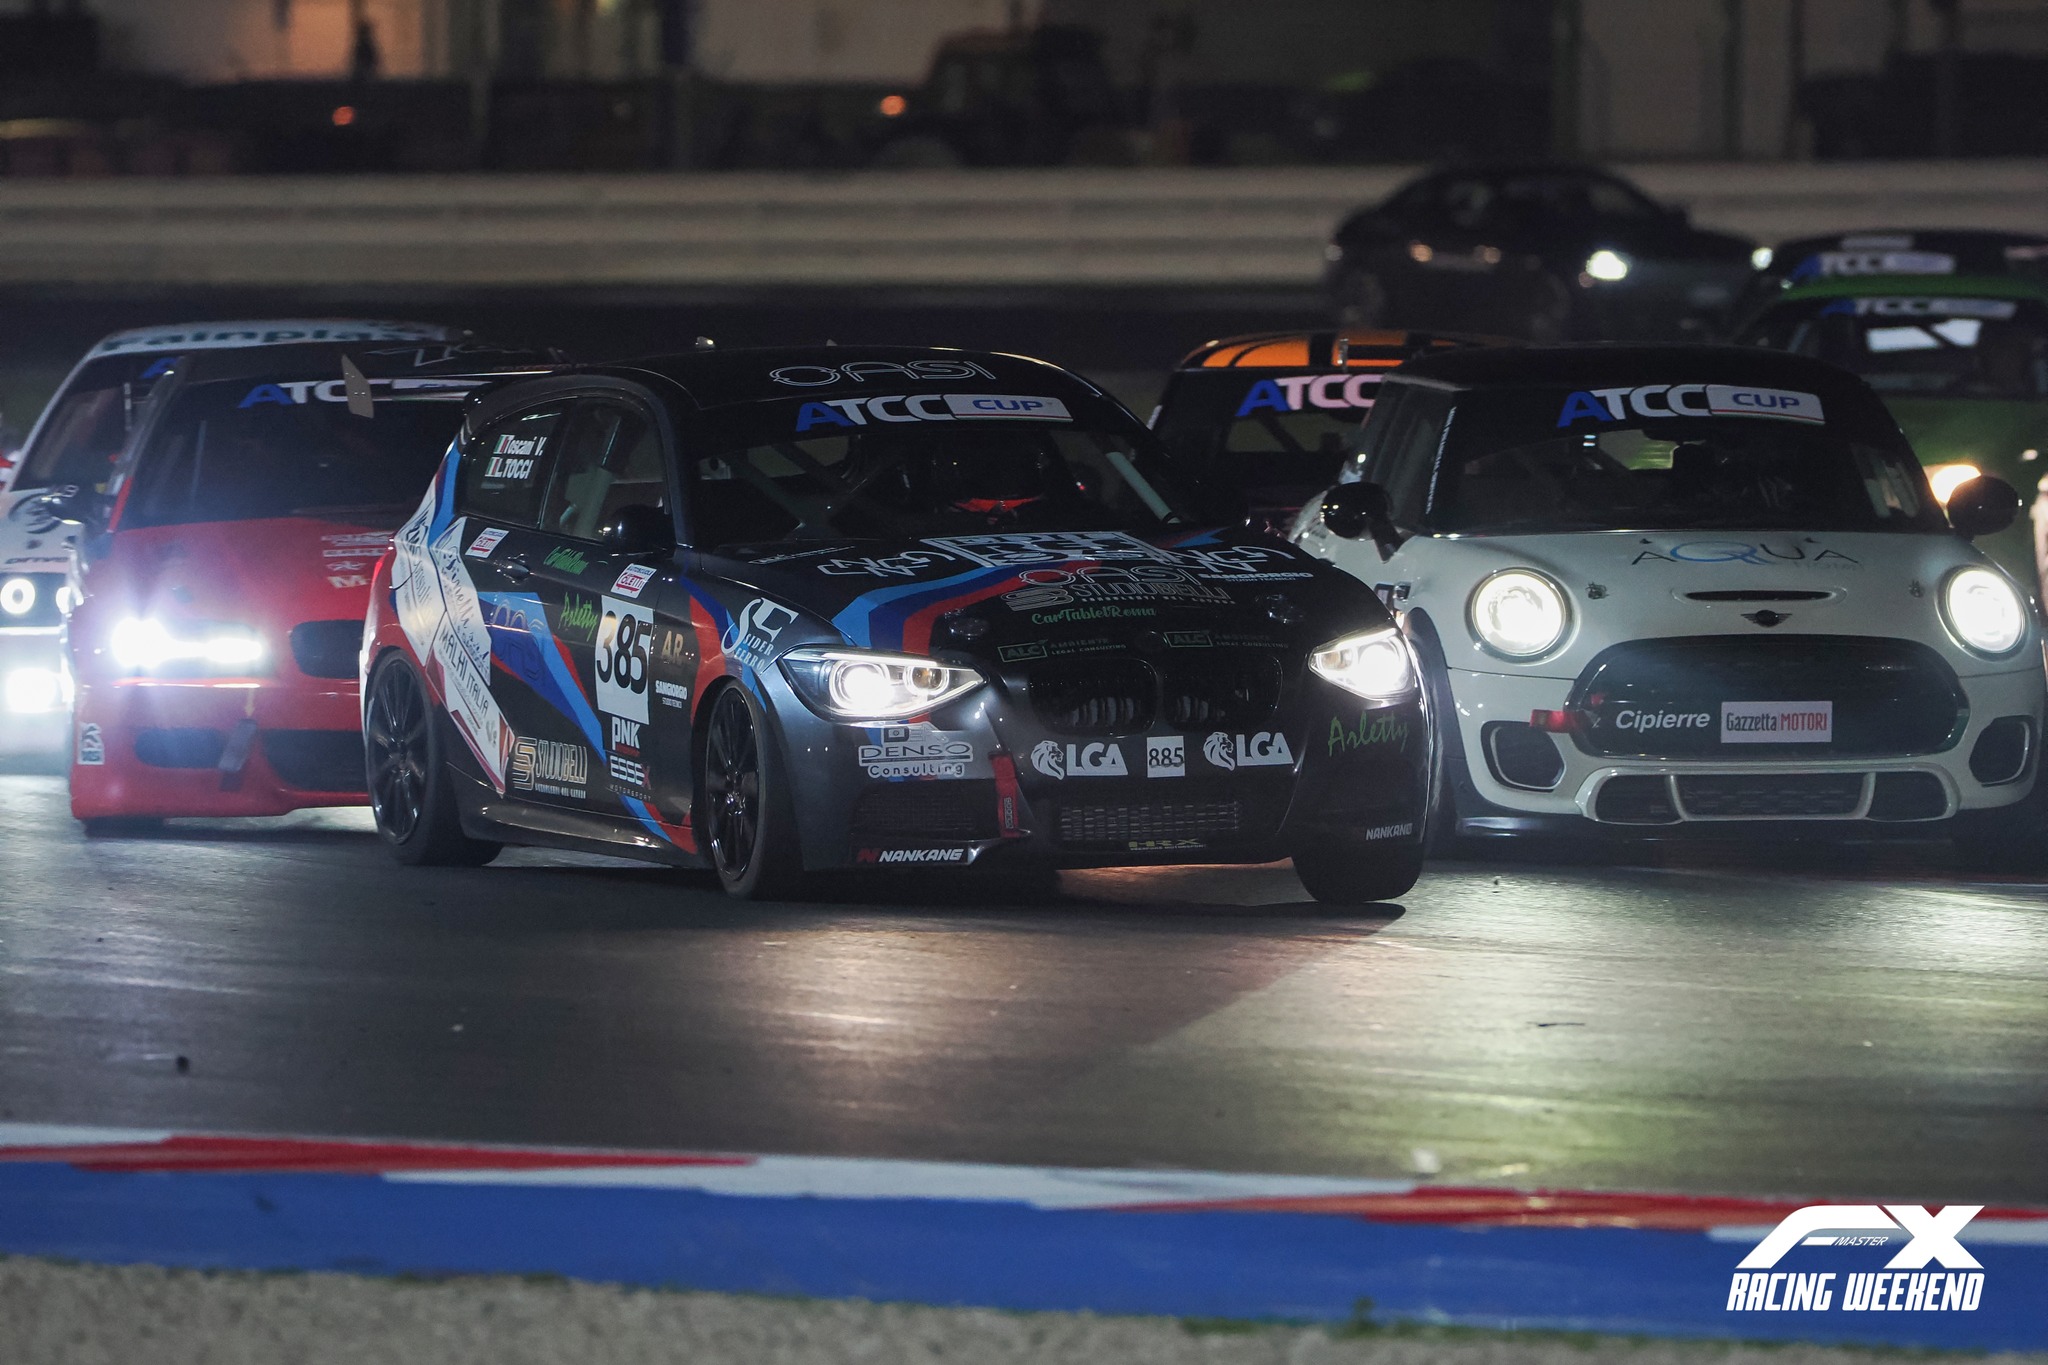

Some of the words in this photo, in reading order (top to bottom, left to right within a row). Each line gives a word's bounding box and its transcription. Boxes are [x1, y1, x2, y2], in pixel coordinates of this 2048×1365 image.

[769, 360, 996, 386] OASI
[795, 394, 955, 432] ATCC
[972, 399, 1043, 411] CUP
[1557, 384, 1712, 428] ATCC
[1732, 393, 1800, 410] CUP
[1632, 540, 1858, 566] AQUA
[1019, 567, 1201, 587] OASI
[743, 633, 774, 656] SIDER
[1615, 709, 1711, 733] Cipierre
[1726, 712, 1777, 732] Gazzetta
[1780, 712, 1828, 731] MOTORI
[612, 716, 640, 750] PNK
[861, 743, 971, 759] DENSO
[1148, 746, 1185, 769] 885
[869, 763, 963, 777] Consulting
[1366, 823, 1413, 840] NANKANG
[879, 849, 964, 863] NANKANG
